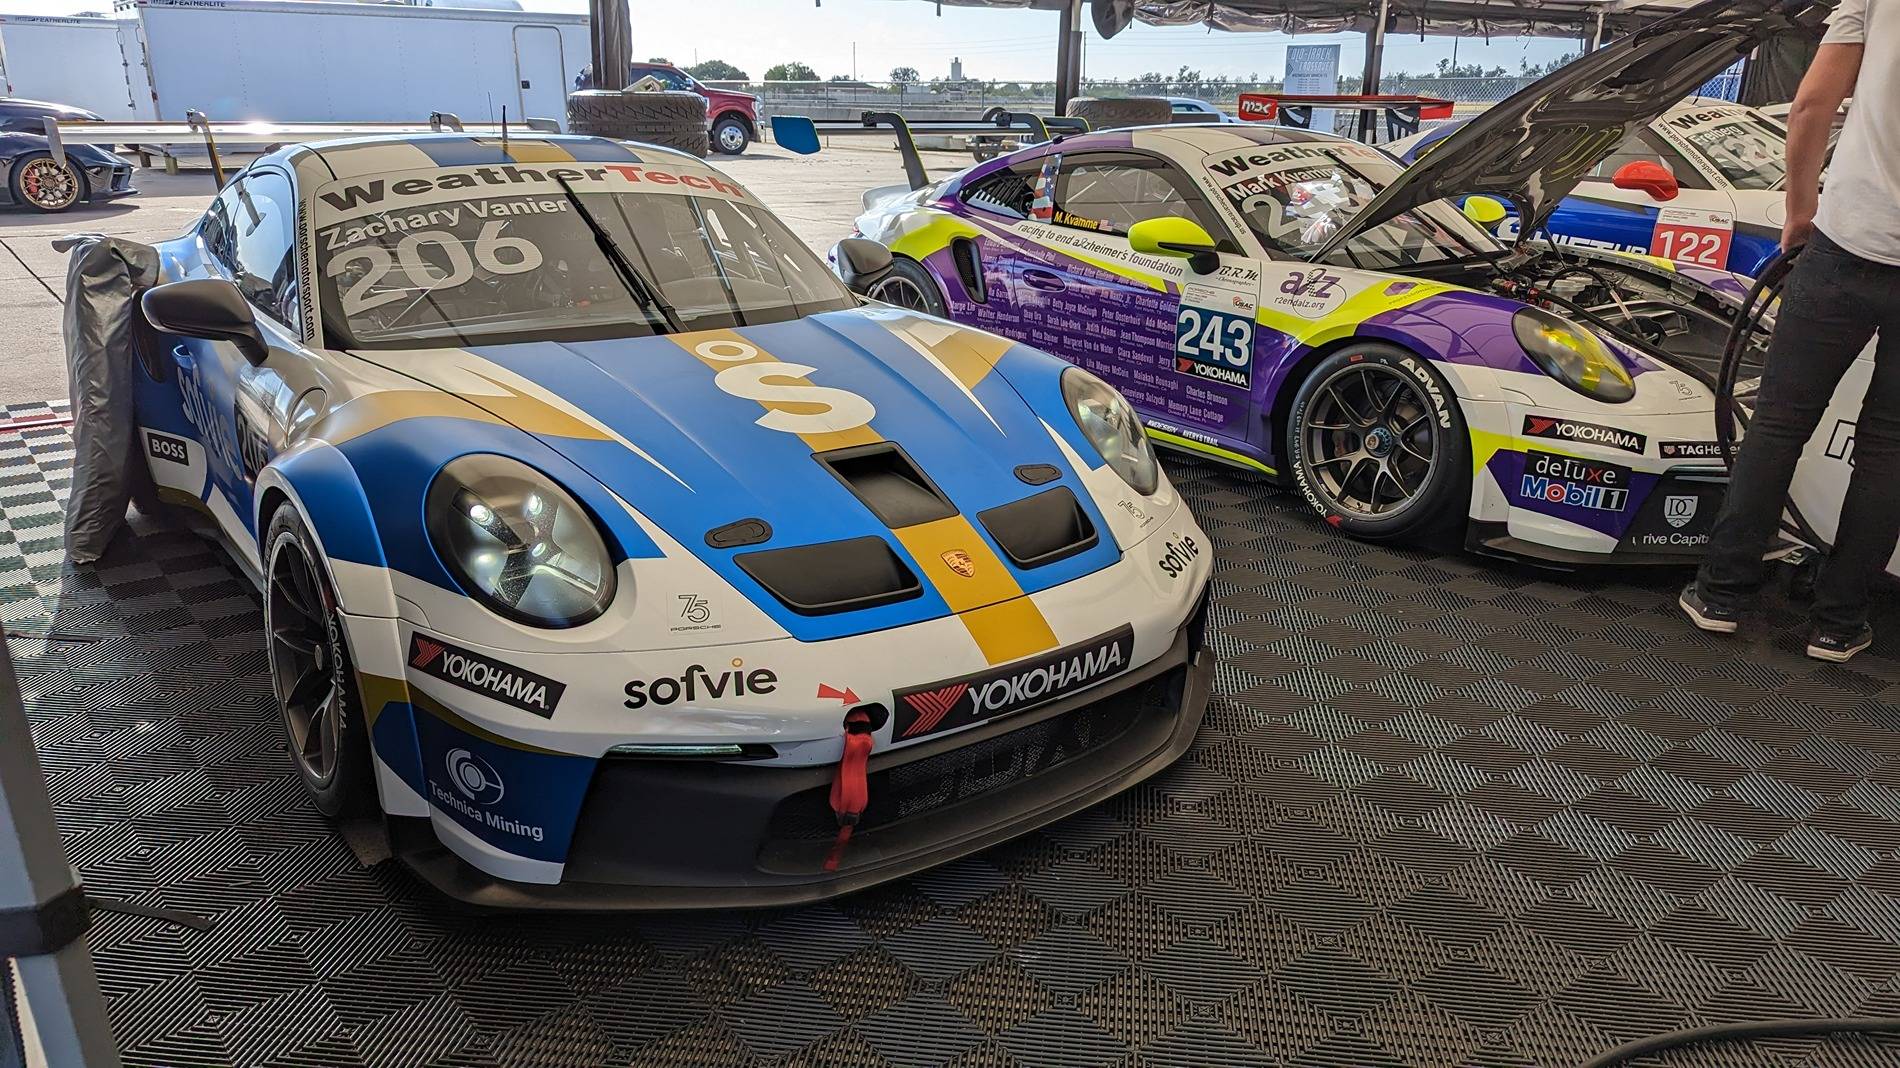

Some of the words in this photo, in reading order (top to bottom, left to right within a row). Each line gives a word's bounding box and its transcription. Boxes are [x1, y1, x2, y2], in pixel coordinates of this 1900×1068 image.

[173, 0, 225, 8] FEATHERLITE
[319, 165, 745, 212] WeatherTech
[1227, 174, 1280, 201] Mark
[320, 207, 460, 252] Zachary
[463, 198, 567, 219] Vanier
[1053, 211, 1063, 223] M.
[1064, 213, 1098, 230] Kvamme
[1018, 224, 1045, 240] racing
[1046, 229, 1055, 240] to
[1055, 232, 1074, 245] end
[1129, 252, 1183, 277] foundation
[1660, 230, 1721, 265] 122
[299, 198, 316, 341] www.porschemotorsport.com
[326, 220, 543, 317] 206
[1274, 297, 1326, 311] r2endalz.org
[1177, 309, 1252, 367] 243
[1185, 384, 1206, 399] Charles
[1194, 362, 1247, 386] YOKOHAMA
[1400, 357, 1451, 429] ADVAN
[1168, 400, 1189, 414] Memory
[1189, 404, 1202, 416] Lane
[1203, 409, 1224, 423] Cottage
[151, 438, 186, 460] BOSS
[1555, 422, 1639, 450] YOKOHAMA
[1536, 455, 1616, 484] deluxe
[1293, 463, 1327, 518] YOKOHAMA
[1520, 474, 1602, 509] Mobil
[1159, 532, 1199, 579] sofvie
[670, 624, 722, 632] PORSCHE
[678, 593, 711, 624] 75
[326, 612, 348, 730] YOKOHAMA
[441, 649, 552, 712] YOKOHAMA
[623, 657, 778, 710] sofvie
[968, 641, 1123, 716] YOKOHAMA
[429, 781, 483, 825] Technica
[486, 811, 544, 843] Mining
